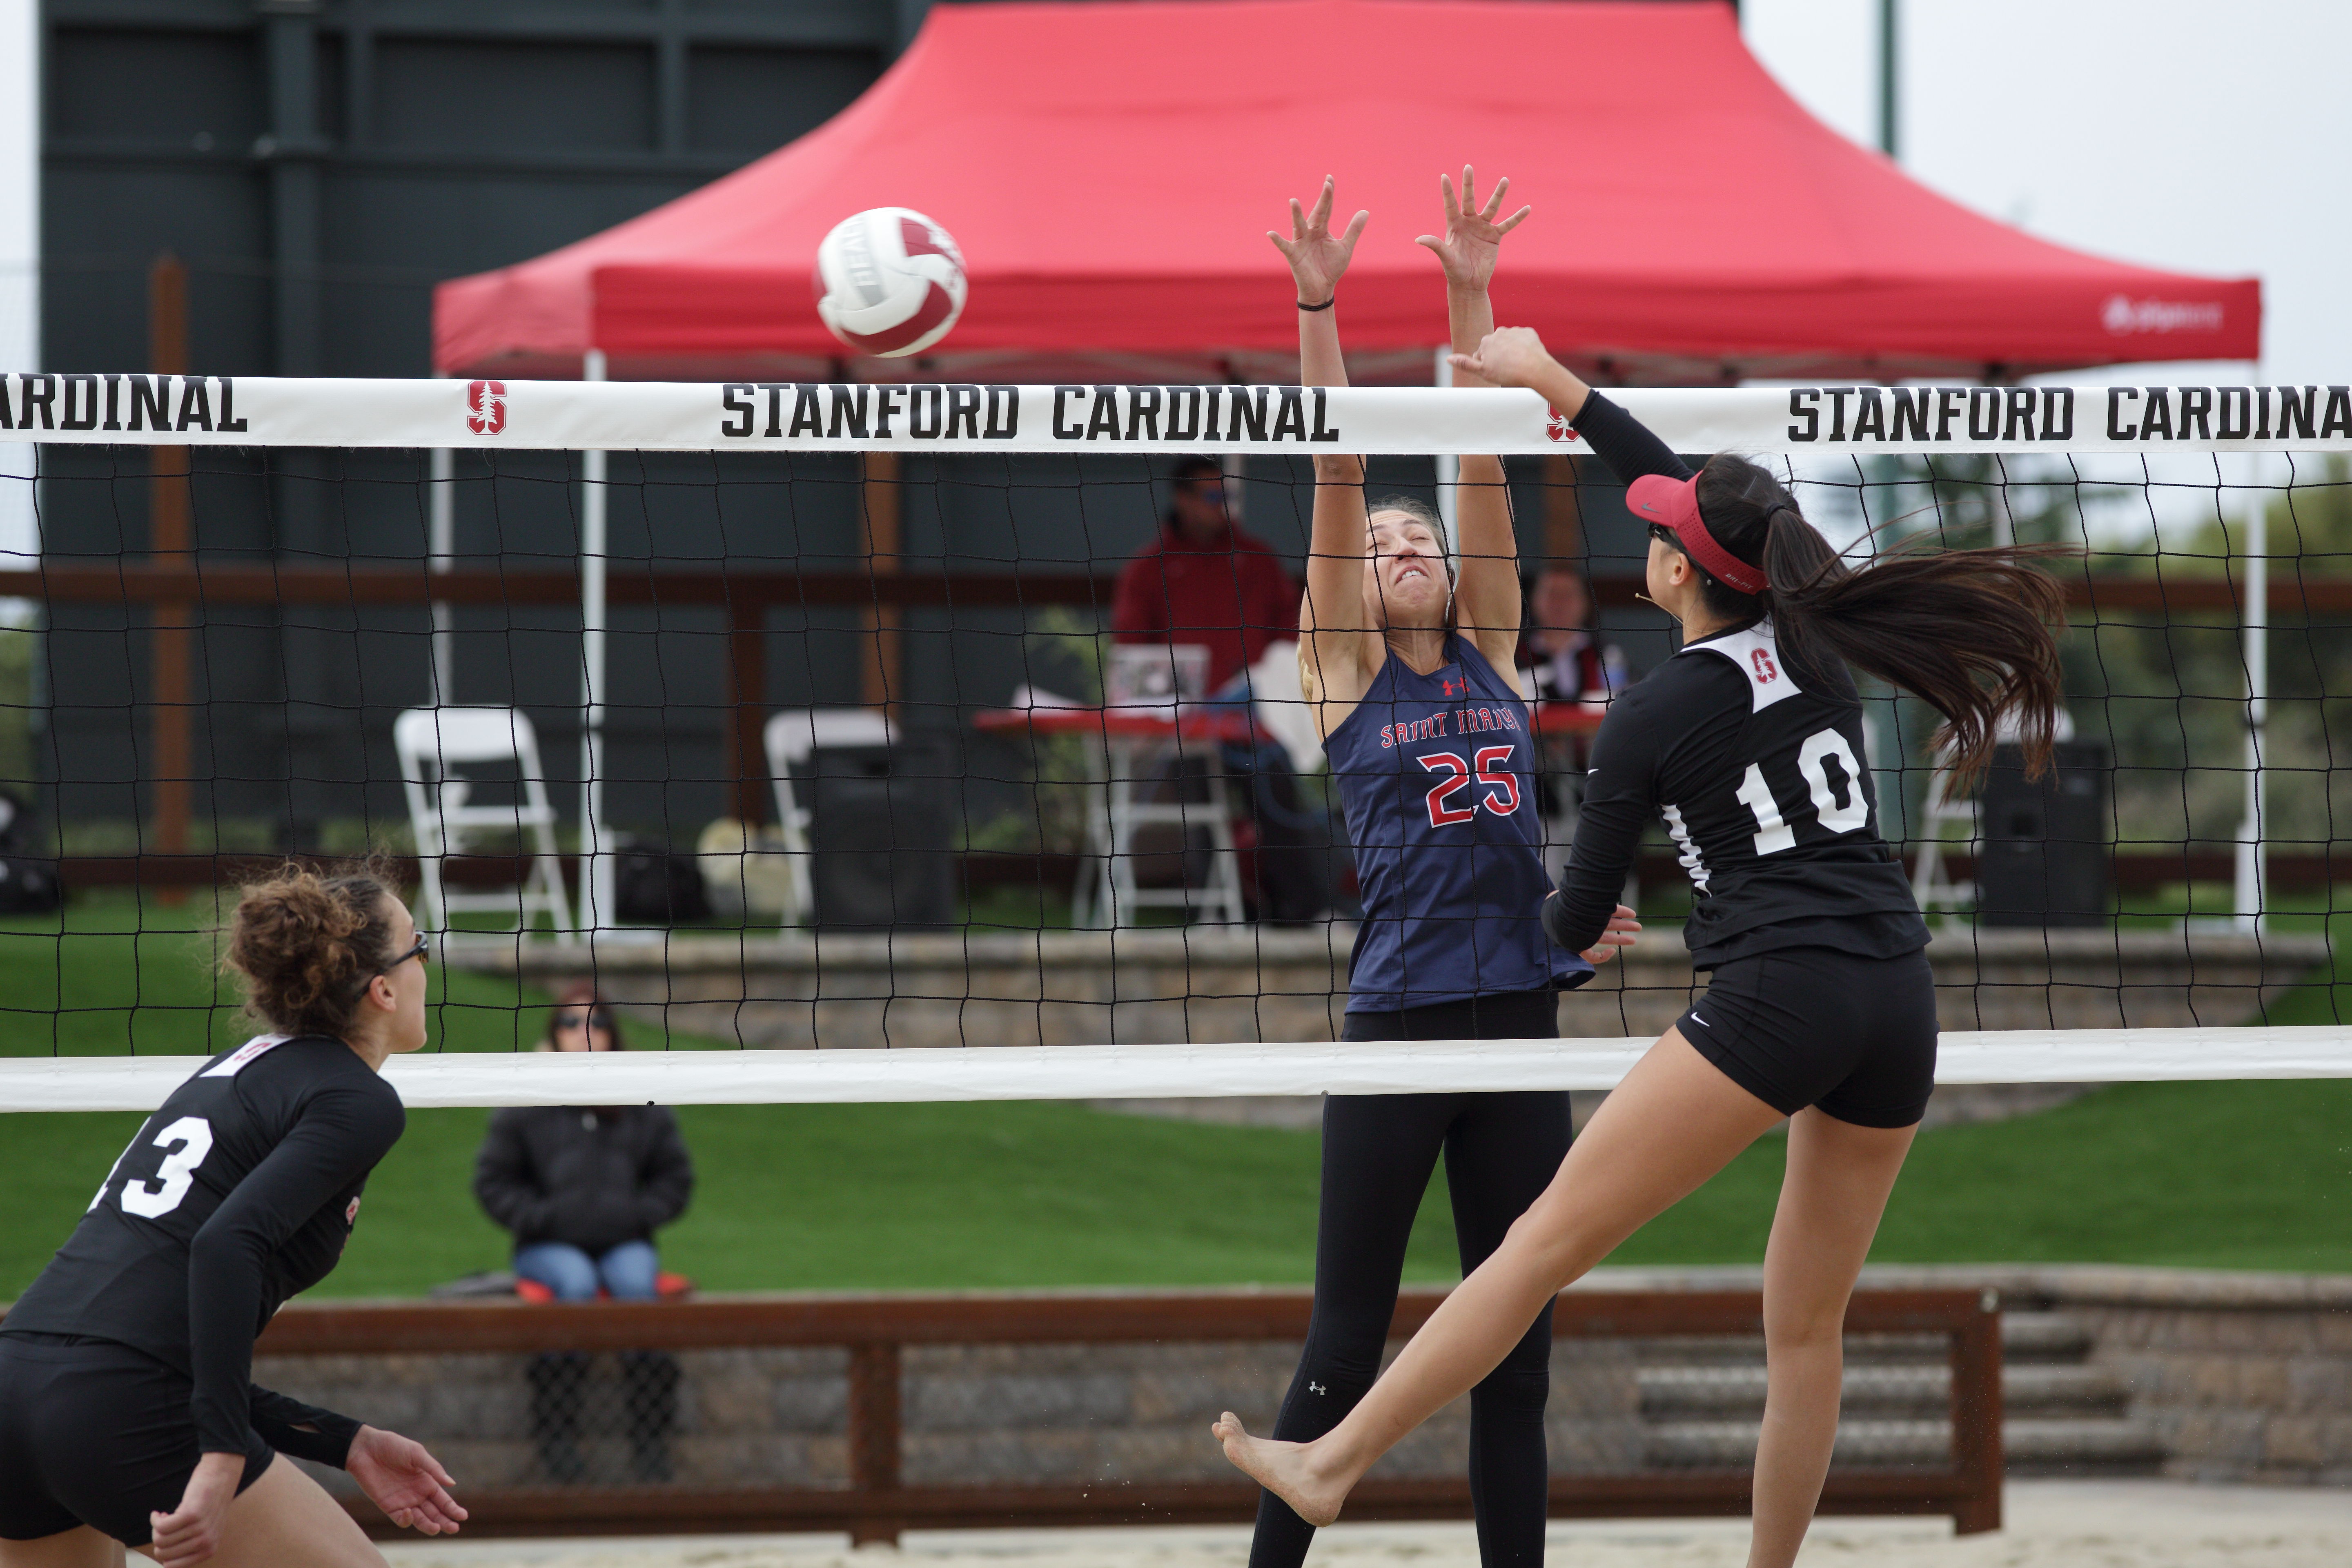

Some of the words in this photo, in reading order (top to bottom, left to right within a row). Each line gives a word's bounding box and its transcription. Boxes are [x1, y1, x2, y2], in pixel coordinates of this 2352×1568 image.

[721, 384, 1018, 439] STANFORD
[1053, 385, 1339, 442] CARDINAL
[1788, 387, 2073, 441] STANFORD
[2107, 386, 2352, 439] CARDINA
[1725, 573, 1754, 589] DRI-FIT
[1381, 712, 1448, 748] SAINT
[1416, 745, 1521, 829] 25
[1735, 728, 1869, 856] 10
